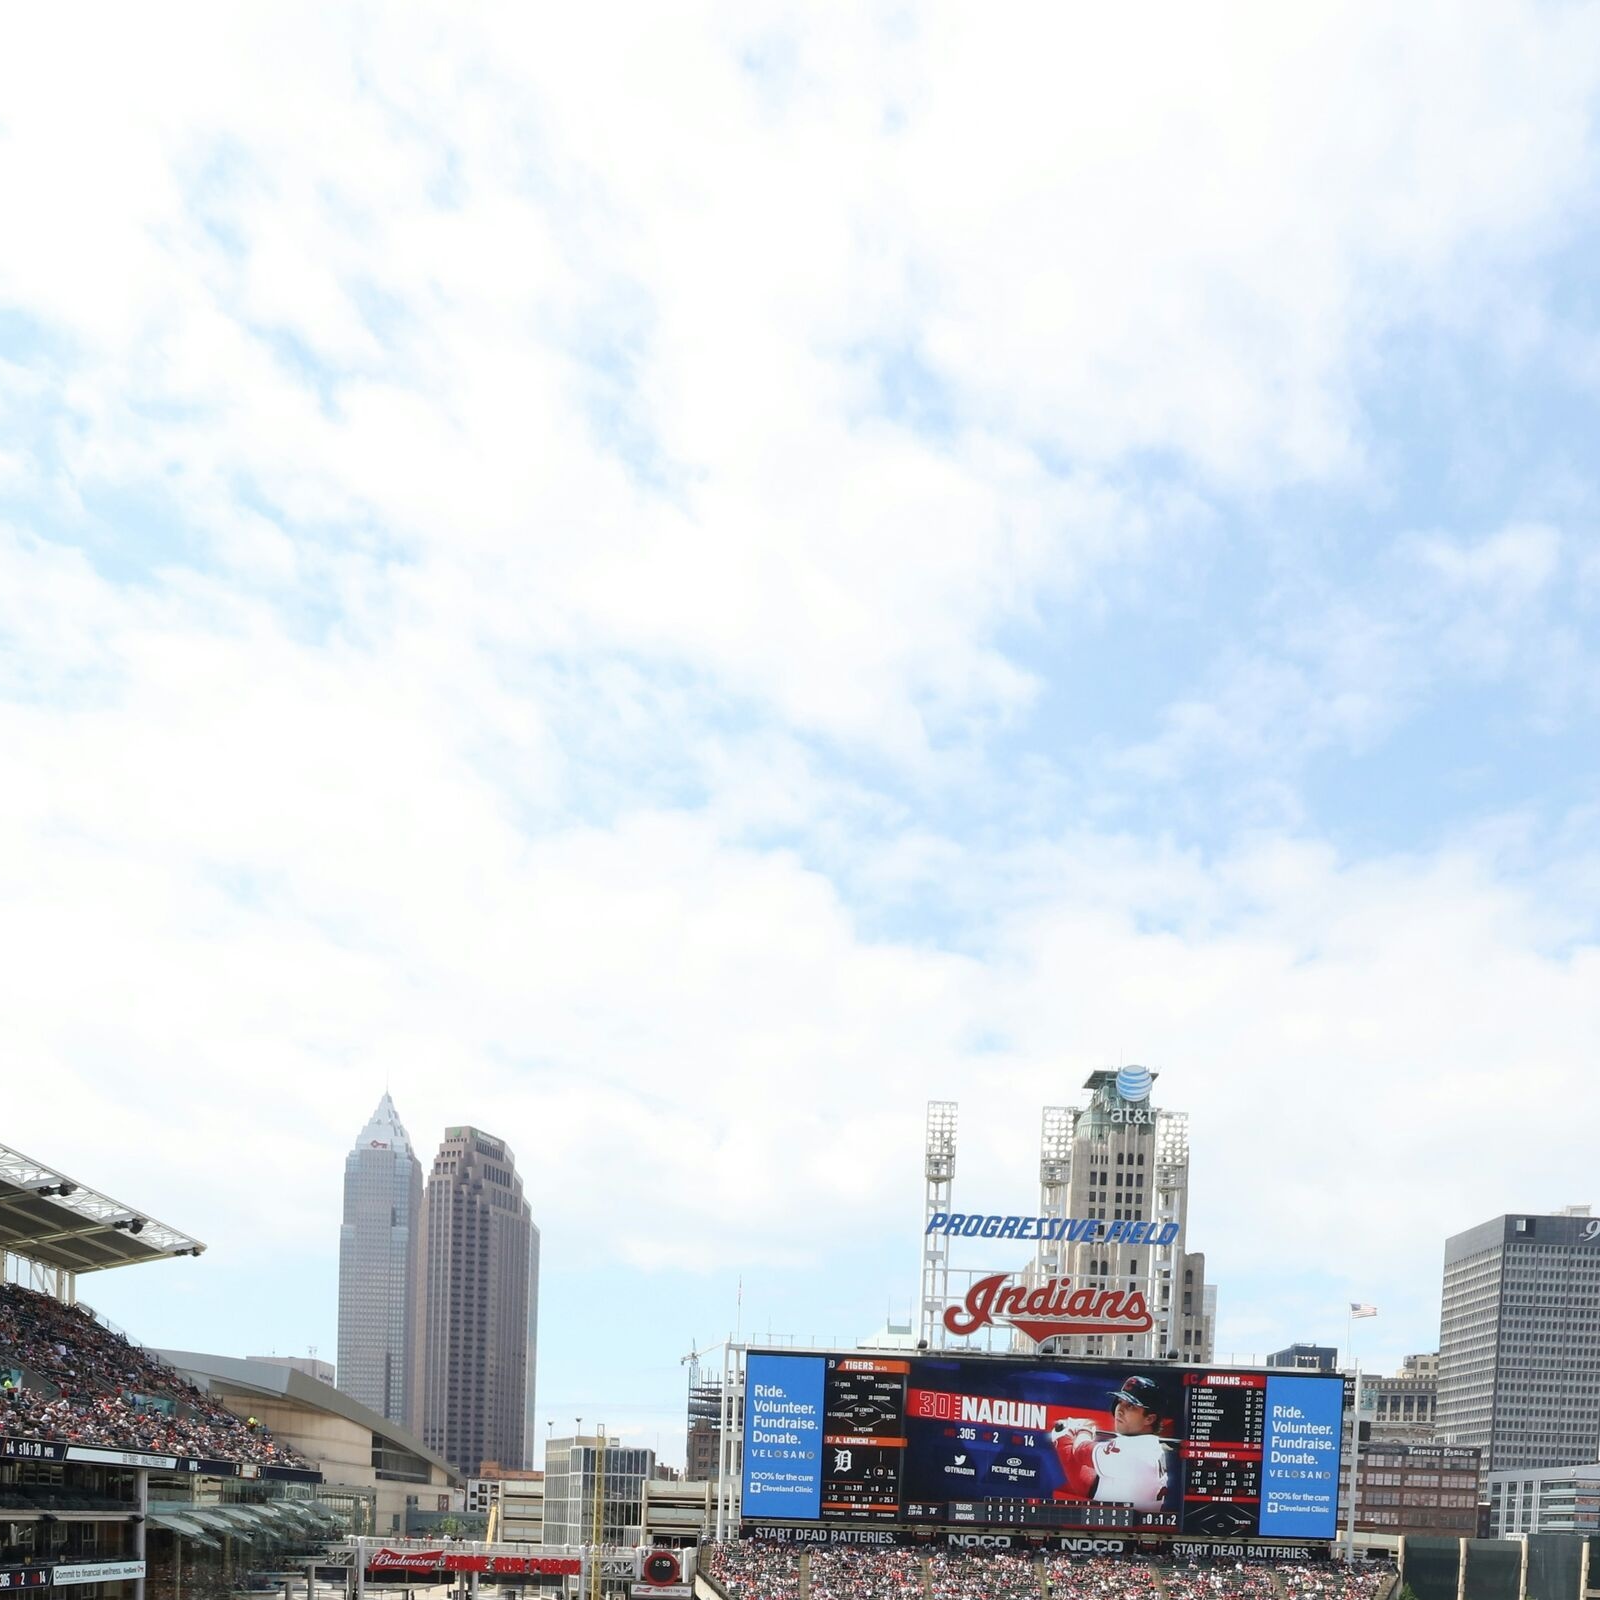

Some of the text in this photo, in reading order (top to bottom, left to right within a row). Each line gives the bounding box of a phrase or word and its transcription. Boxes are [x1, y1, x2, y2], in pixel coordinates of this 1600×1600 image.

[925, 1213, 1179, 1246] PROGRESSIVE FIELD
[943, 1274, 1154, 1336] Indians
[845, 1360, 874, 1371] TIGERS
[1207, 1375, 1240, 1385] INDIANS
[754, 1385, 787, 1398] Ride.
[754, 1400, 816, 1415] Volunteer.
[919, 1391, 951, 1419] 30
[962, 1396, 1047, 1430] NAQUIN
[1273, 1405, 1305, 1419] Ride.
[753, 1415, 819, 1430] Fundraise.
[1272, 1421, 1334, 1435] Volunteer.
[753, 1431, 801, 1444] Donate.
[1271, 1436, 1335, 1450] Fundraise.
[752, 1449, 815, 1460] VELOSANO
[1271, 1451, 1319, 1465] Donate.
[944, 1466, 975, 1476] @TYNAQUIN
[1269, 1469, 1331, 1480] VELOSANO
[762, 1484, 813, 1494] Cleveland Clinic
[1279, 1504, 1311, 1512] Cleveland
[755, 1527, 897, 1545] START DEAD BATTERIES.
[948, 1534, 1011, 1548] NOCO
[1061, 1538, 1124, 1552] NOCO
[1172, 1543, 1312, 1560] START DEAD BATTERIES.
[374, 1552, 437, 1569] Budweiser
